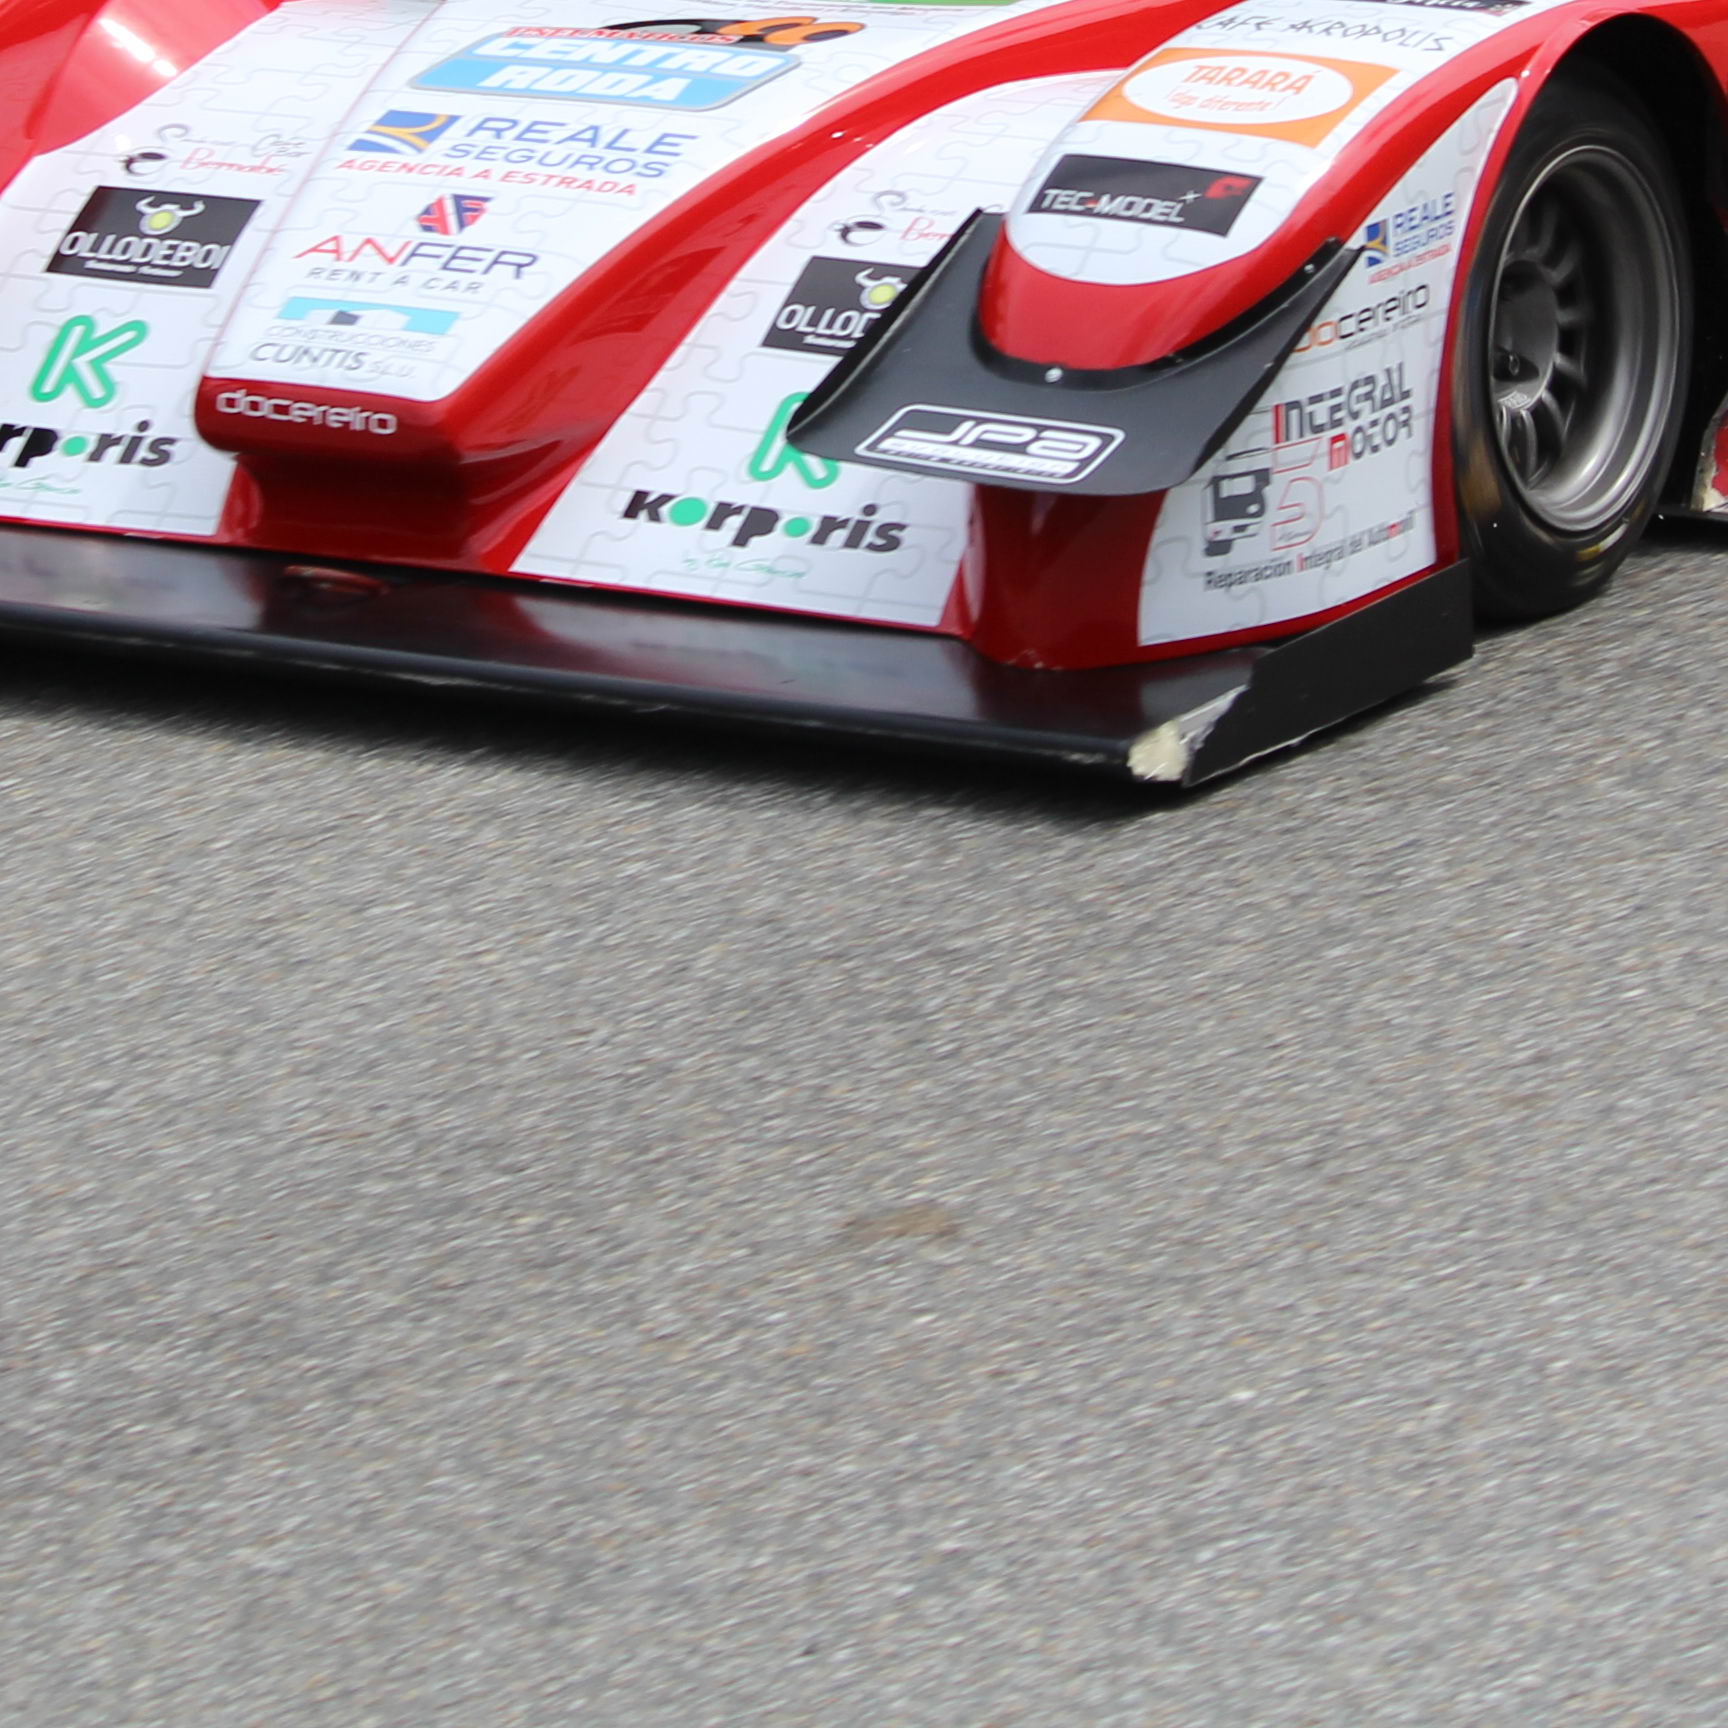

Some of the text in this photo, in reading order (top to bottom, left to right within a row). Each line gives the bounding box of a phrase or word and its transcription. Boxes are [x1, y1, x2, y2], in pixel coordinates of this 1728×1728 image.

[472, 38, 786, 77] CENTRO
[477, 64, 692, 101] RODA
[466, 116, 702, 157] REALE
[335, 158, 637, 197] AGENCIA A ESTRADA
[441, 142, 673, 179] SEGUROS
[59, 231, 232, 270] OLLODEBOI
[291, 234, 540, 279] ANFER
[306, 267, 485, 294] RENT A CAR
[30, 314, 150, 409] K
[248, 342, 369, 371] CUNTIS
[216, 388, 398, 435] docereiro
